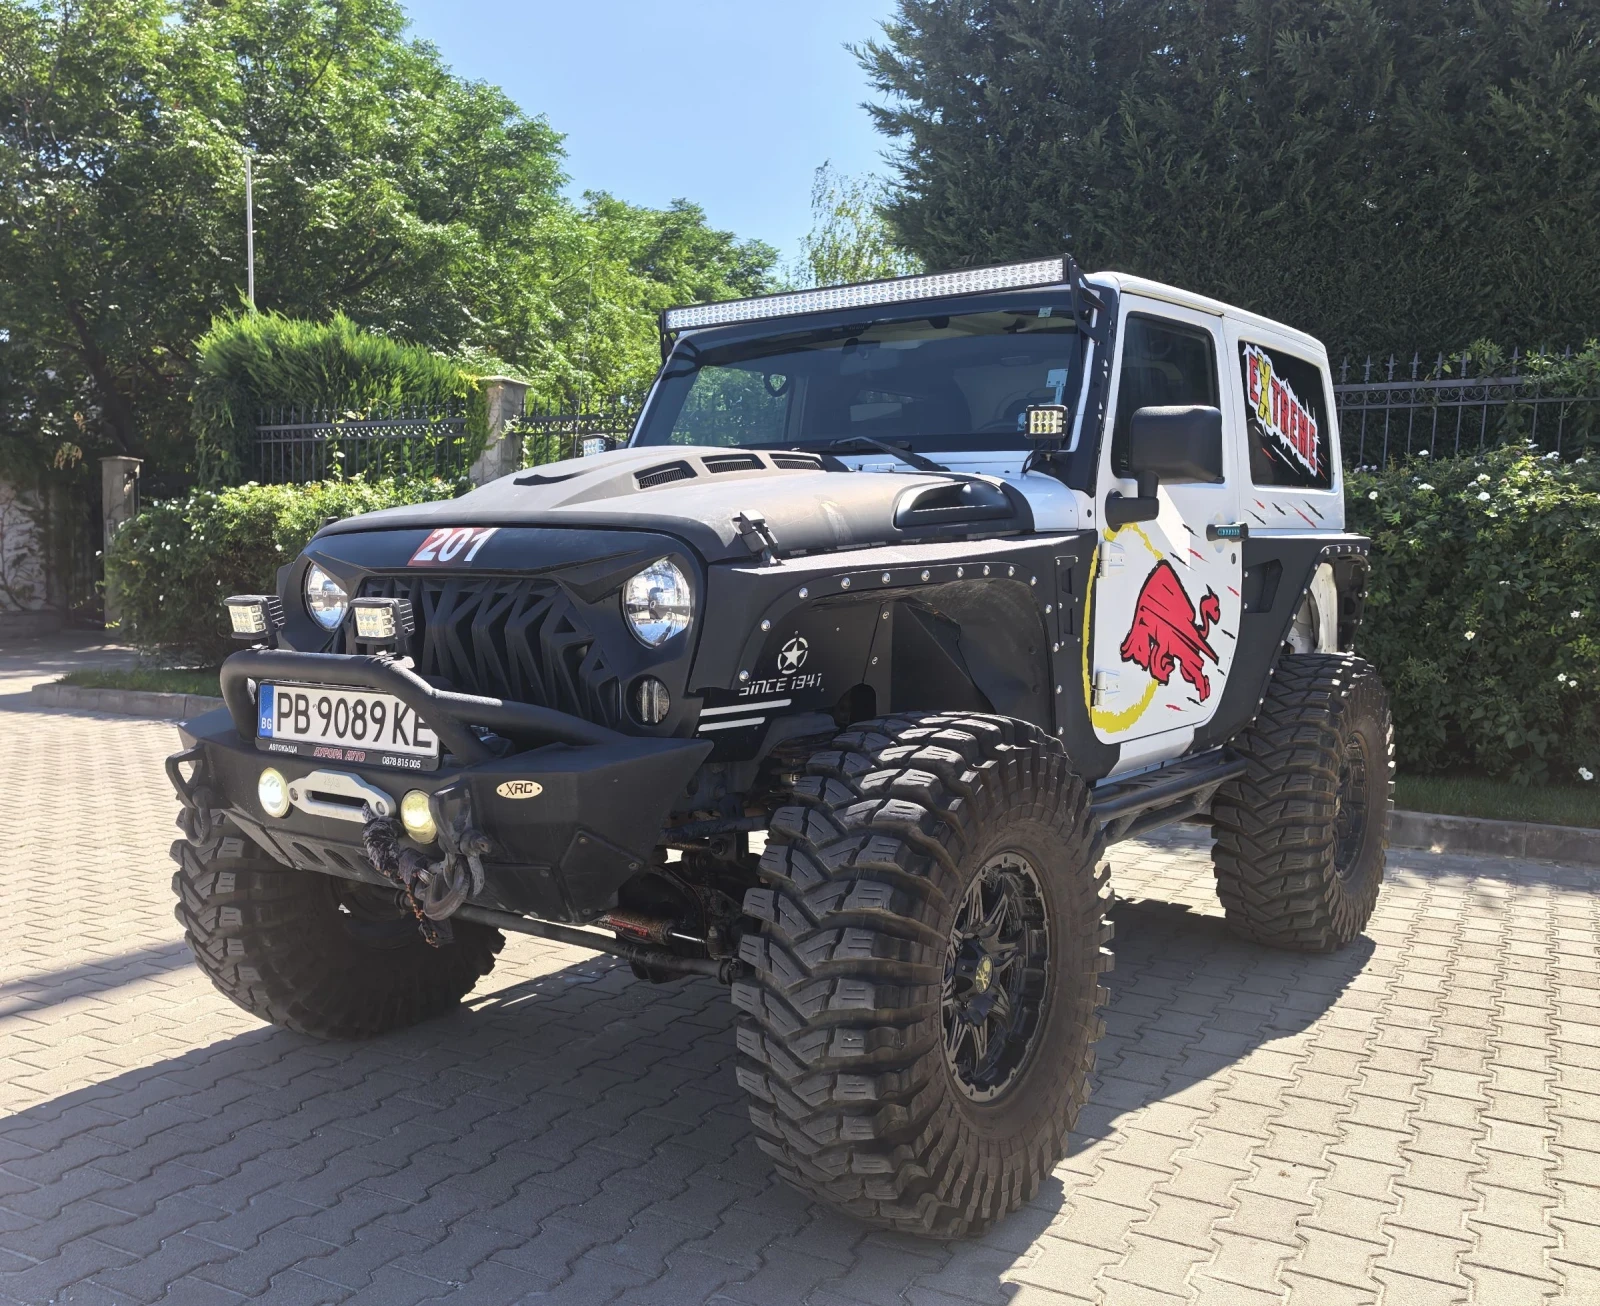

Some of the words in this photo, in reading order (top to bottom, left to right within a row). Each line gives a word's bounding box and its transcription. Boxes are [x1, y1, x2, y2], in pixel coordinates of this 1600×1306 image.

[1248, 351, 1316, 471] EXTREME
[413, 527, 499, 562] 201
[738, 677, 788, 696] SINCE
[791, 673, 823, 690] 1941
[261, 717, 272, 730] BG
[276, 692, 311, 734] PB
[317, 696, 387, 743] 9089
[382, 756, 396, 767] 0878
[397, 757, 409, 768] 815
[505, 782, 533, 796] XRC
